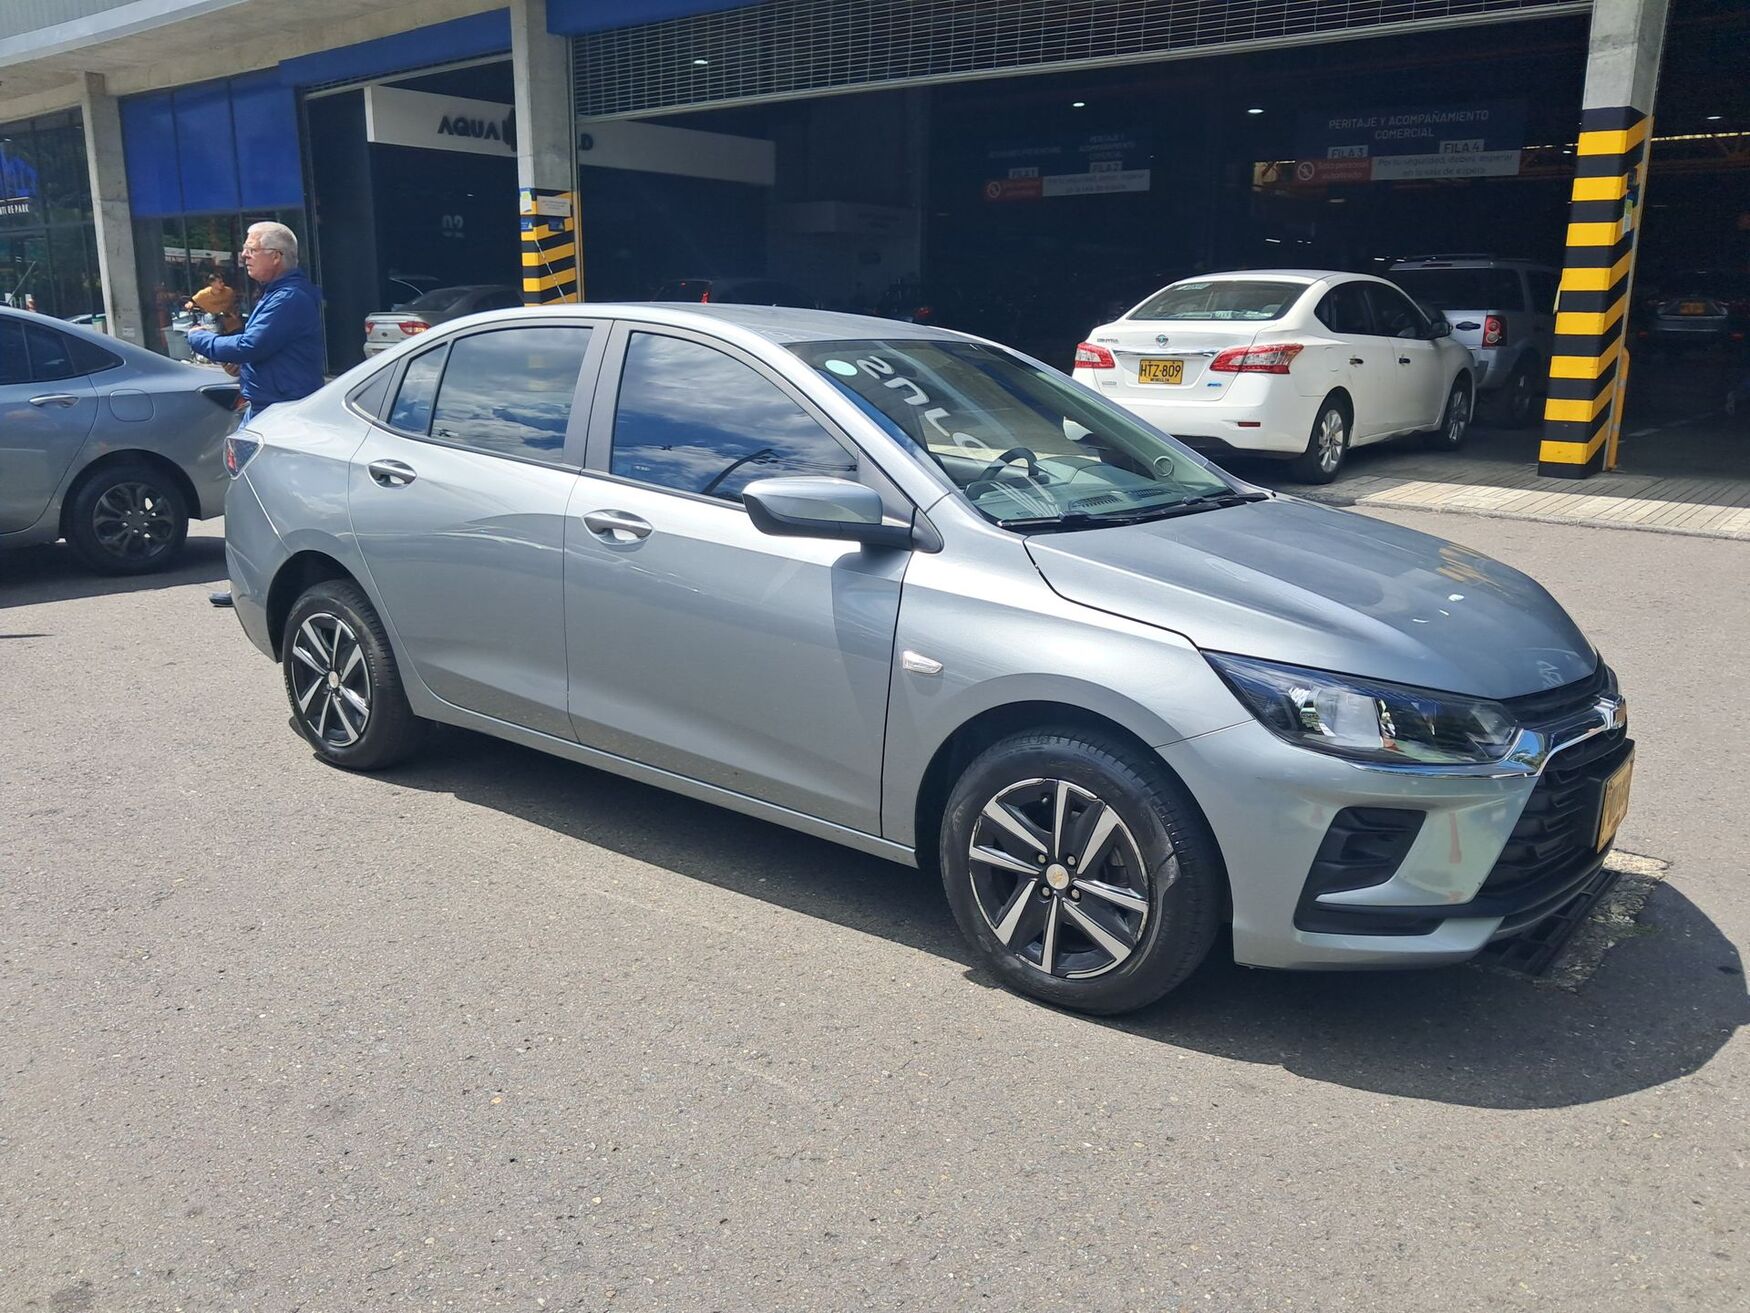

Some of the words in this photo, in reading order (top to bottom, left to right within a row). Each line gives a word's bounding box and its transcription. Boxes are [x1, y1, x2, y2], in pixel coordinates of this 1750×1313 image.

[1328, 118, 1377, 129] PERITAJE
[1379, 117, 1386, 126] Y
[1388, 110, 1489, 126] ACOMPAÑAMIENTO
[437, 115, 500, 141] AQUA
[1375, 127, 1435, 140] COMERCIAL
[1331, 149, 1355, 158] FILA
[1443, 143, 1468, 153] FILA
[1472, 142, 1480, 152] 4
